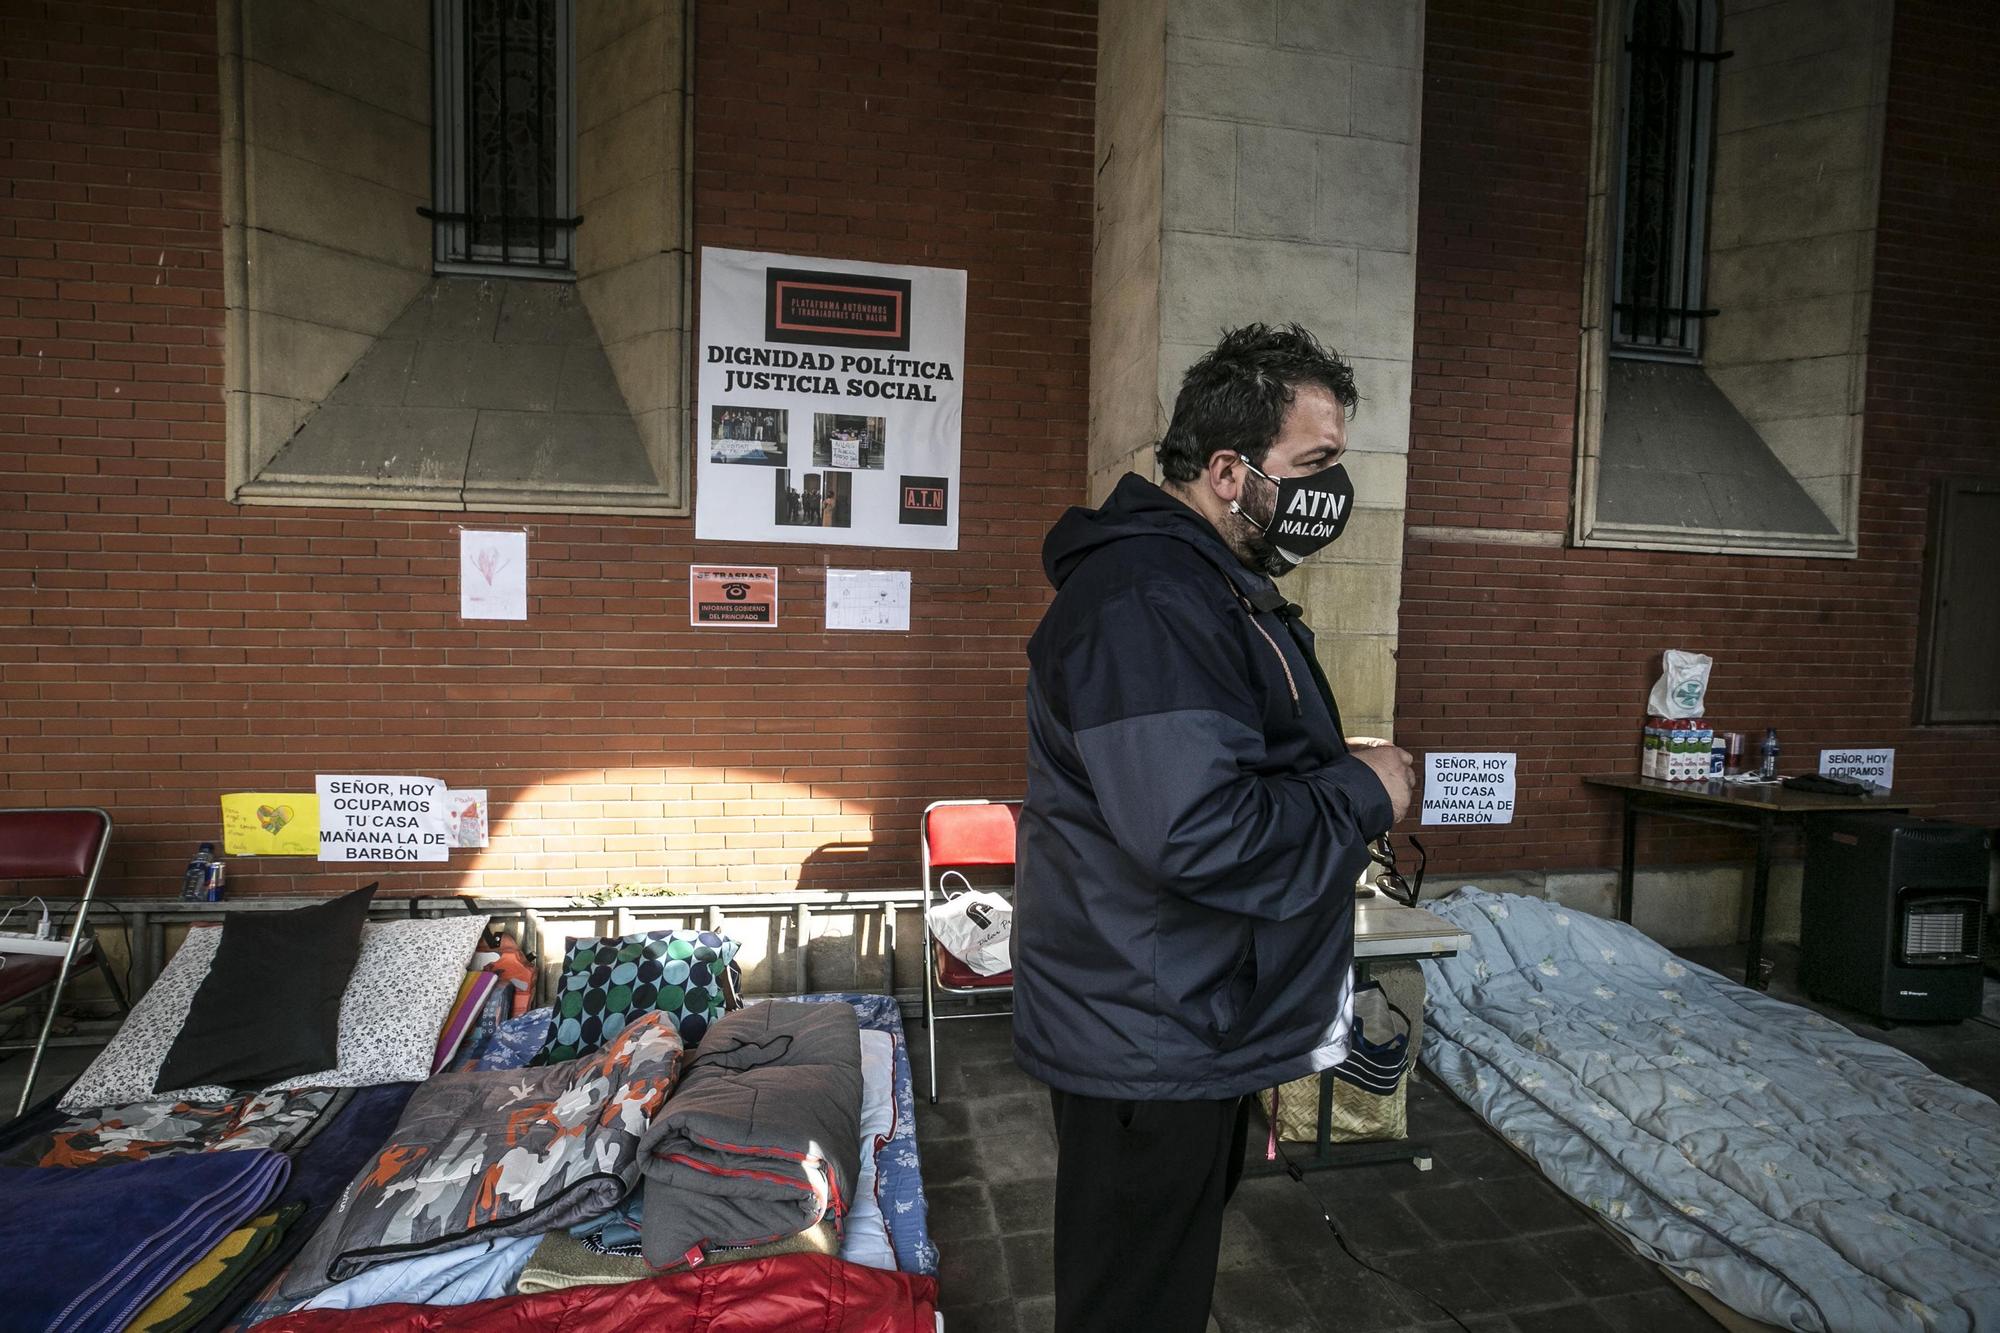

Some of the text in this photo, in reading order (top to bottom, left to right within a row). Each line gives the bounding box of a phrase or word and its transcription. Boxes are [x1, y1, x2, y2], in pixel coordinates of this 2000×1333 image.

[791, 298, 840, 310] PLATAFORMA
[851, 313, 863, 321] DEL
[707, 345, 954, 381] DIGNIDAD POLÍTICA
[725, 371, 937, 402] JUSTICIA SOCIAL
[907, 490, 941, 508] A.T.N
[1286, 488, 1346, 520] ATN
[1278, 520, 1334, 538] NALÓN
[712, 571, 769, 580] TRASPASA
[1435, 757, 1508, 770] SEÑOR, HOY
[1828, 753, 1888, 765] SEÑOR, HOY
[1437, 772, 1504, 783] OCUPAMOS
[1829, 766, 1885, 777] OCUPAMOS
[330, 780, 436, 796] SEÑOR, HOY
[1444, 786, 1496, 797] TU CASA
[334, 798, 431, 813] OCUPAMOS
[1424, 798, 1512, 810] MAÑANA LA DE
[345, 815, 420, 829] TU CASA
[1441, 811, 1492, 823] BARBÓN
[320, 828, 445, 845] MAÑANA LA DE
[346, 844, 419, 861] BARBÓN
